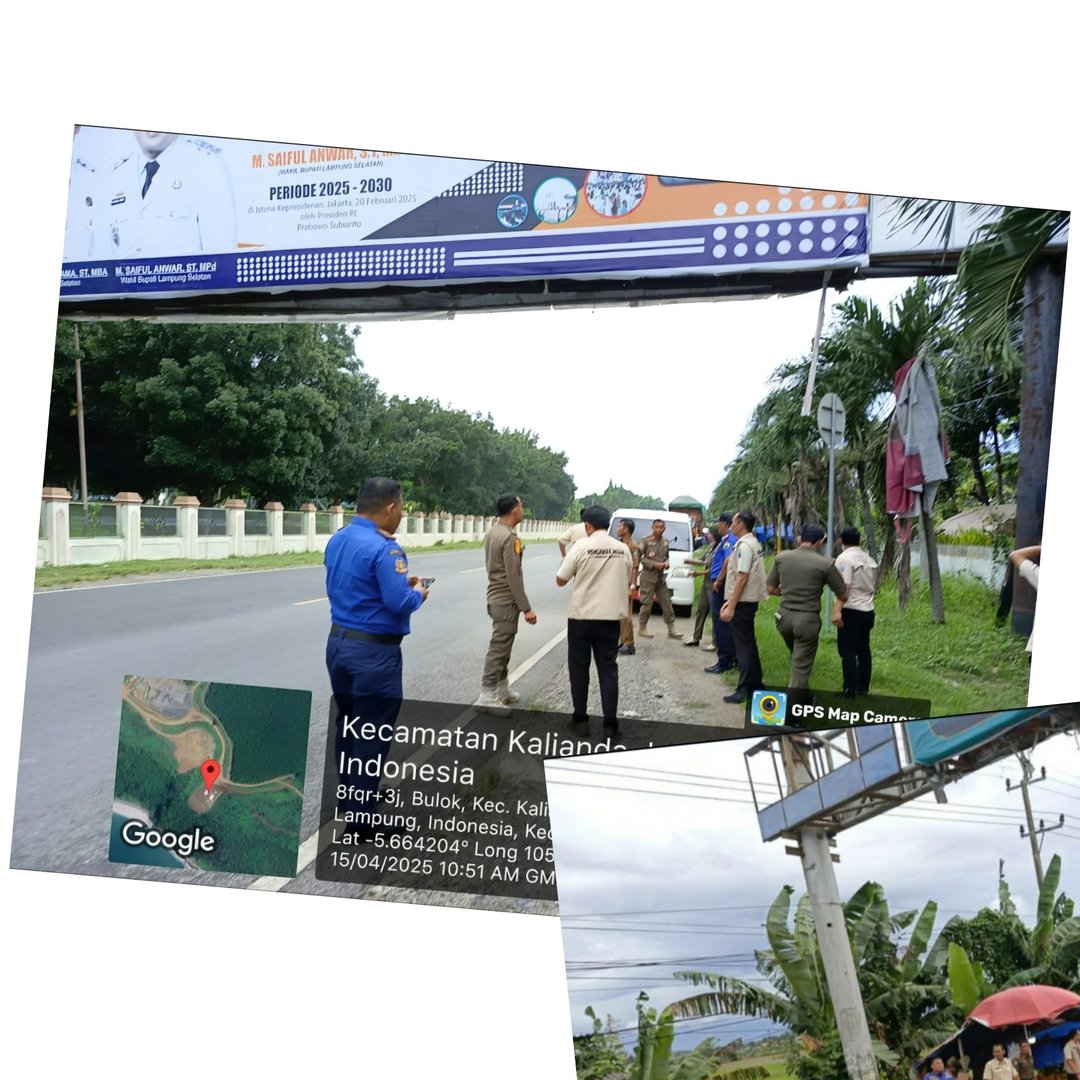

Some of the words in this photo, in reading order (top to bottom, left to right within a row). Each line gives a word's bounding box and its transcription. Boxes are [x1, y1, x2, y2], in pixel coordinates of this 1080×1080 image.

[252, 153, 265, 168] M.
[268, 149, 307, 167] SAIFUL
[269, 183, 317, 201] PERIODE
[319, 180, 350, 197] 2025
[360, 177, 392, 194] 2030
[355, 197, 365, 207] 20
[366, 195, 397, 206] Februari
[398, 194, 417, 204] 2025
[91, 267, 108, 277] MBA
[125, 264, 153, 275] SAIFUL
[199, 261, 217, 271] MPd
[158, 274, 186, 283] Lampung
[187, 273, 212, 282] Selatan
